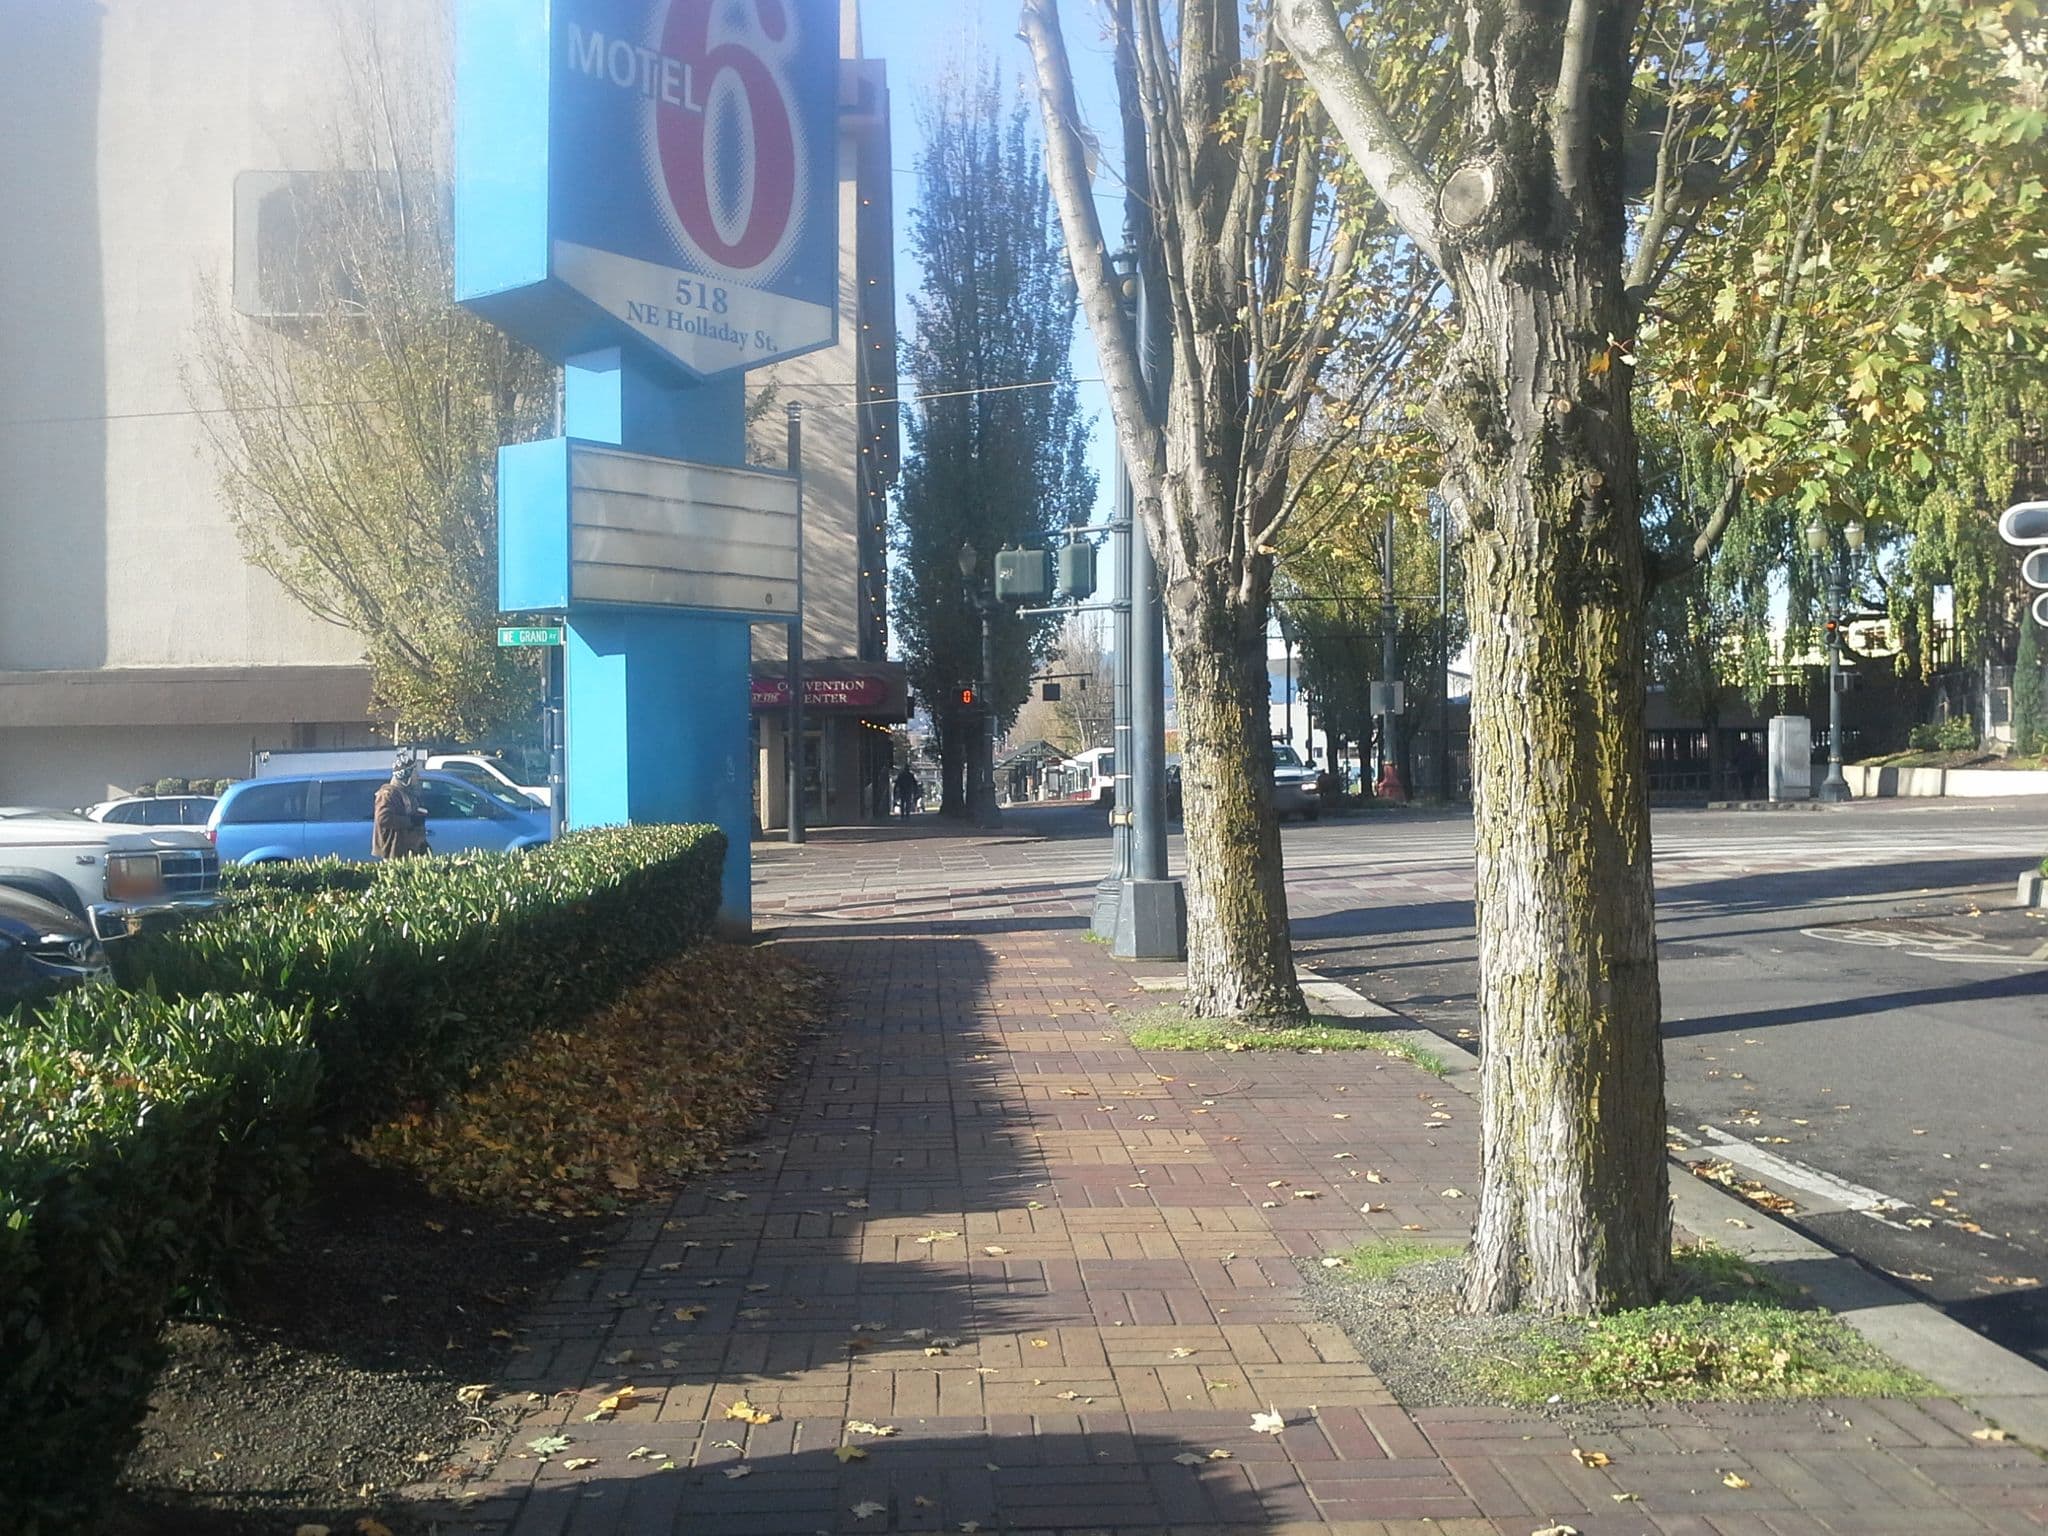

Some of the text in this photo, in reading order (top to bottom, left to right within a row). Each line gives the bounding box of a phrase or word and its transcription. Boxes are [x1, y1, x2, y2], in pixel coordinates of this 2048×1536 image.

[568, 0, 796, 270] MOTEL 6
[676, 278, 728, 315] 518
[627, 300, 778, 352] NE Holladay St.
[502, 630, 514, 643] NE
[519, 630, 548, 643] GRAND
[777, 680, 865, 692] CVENTION
[803, 693, 848, 704] ENTER
